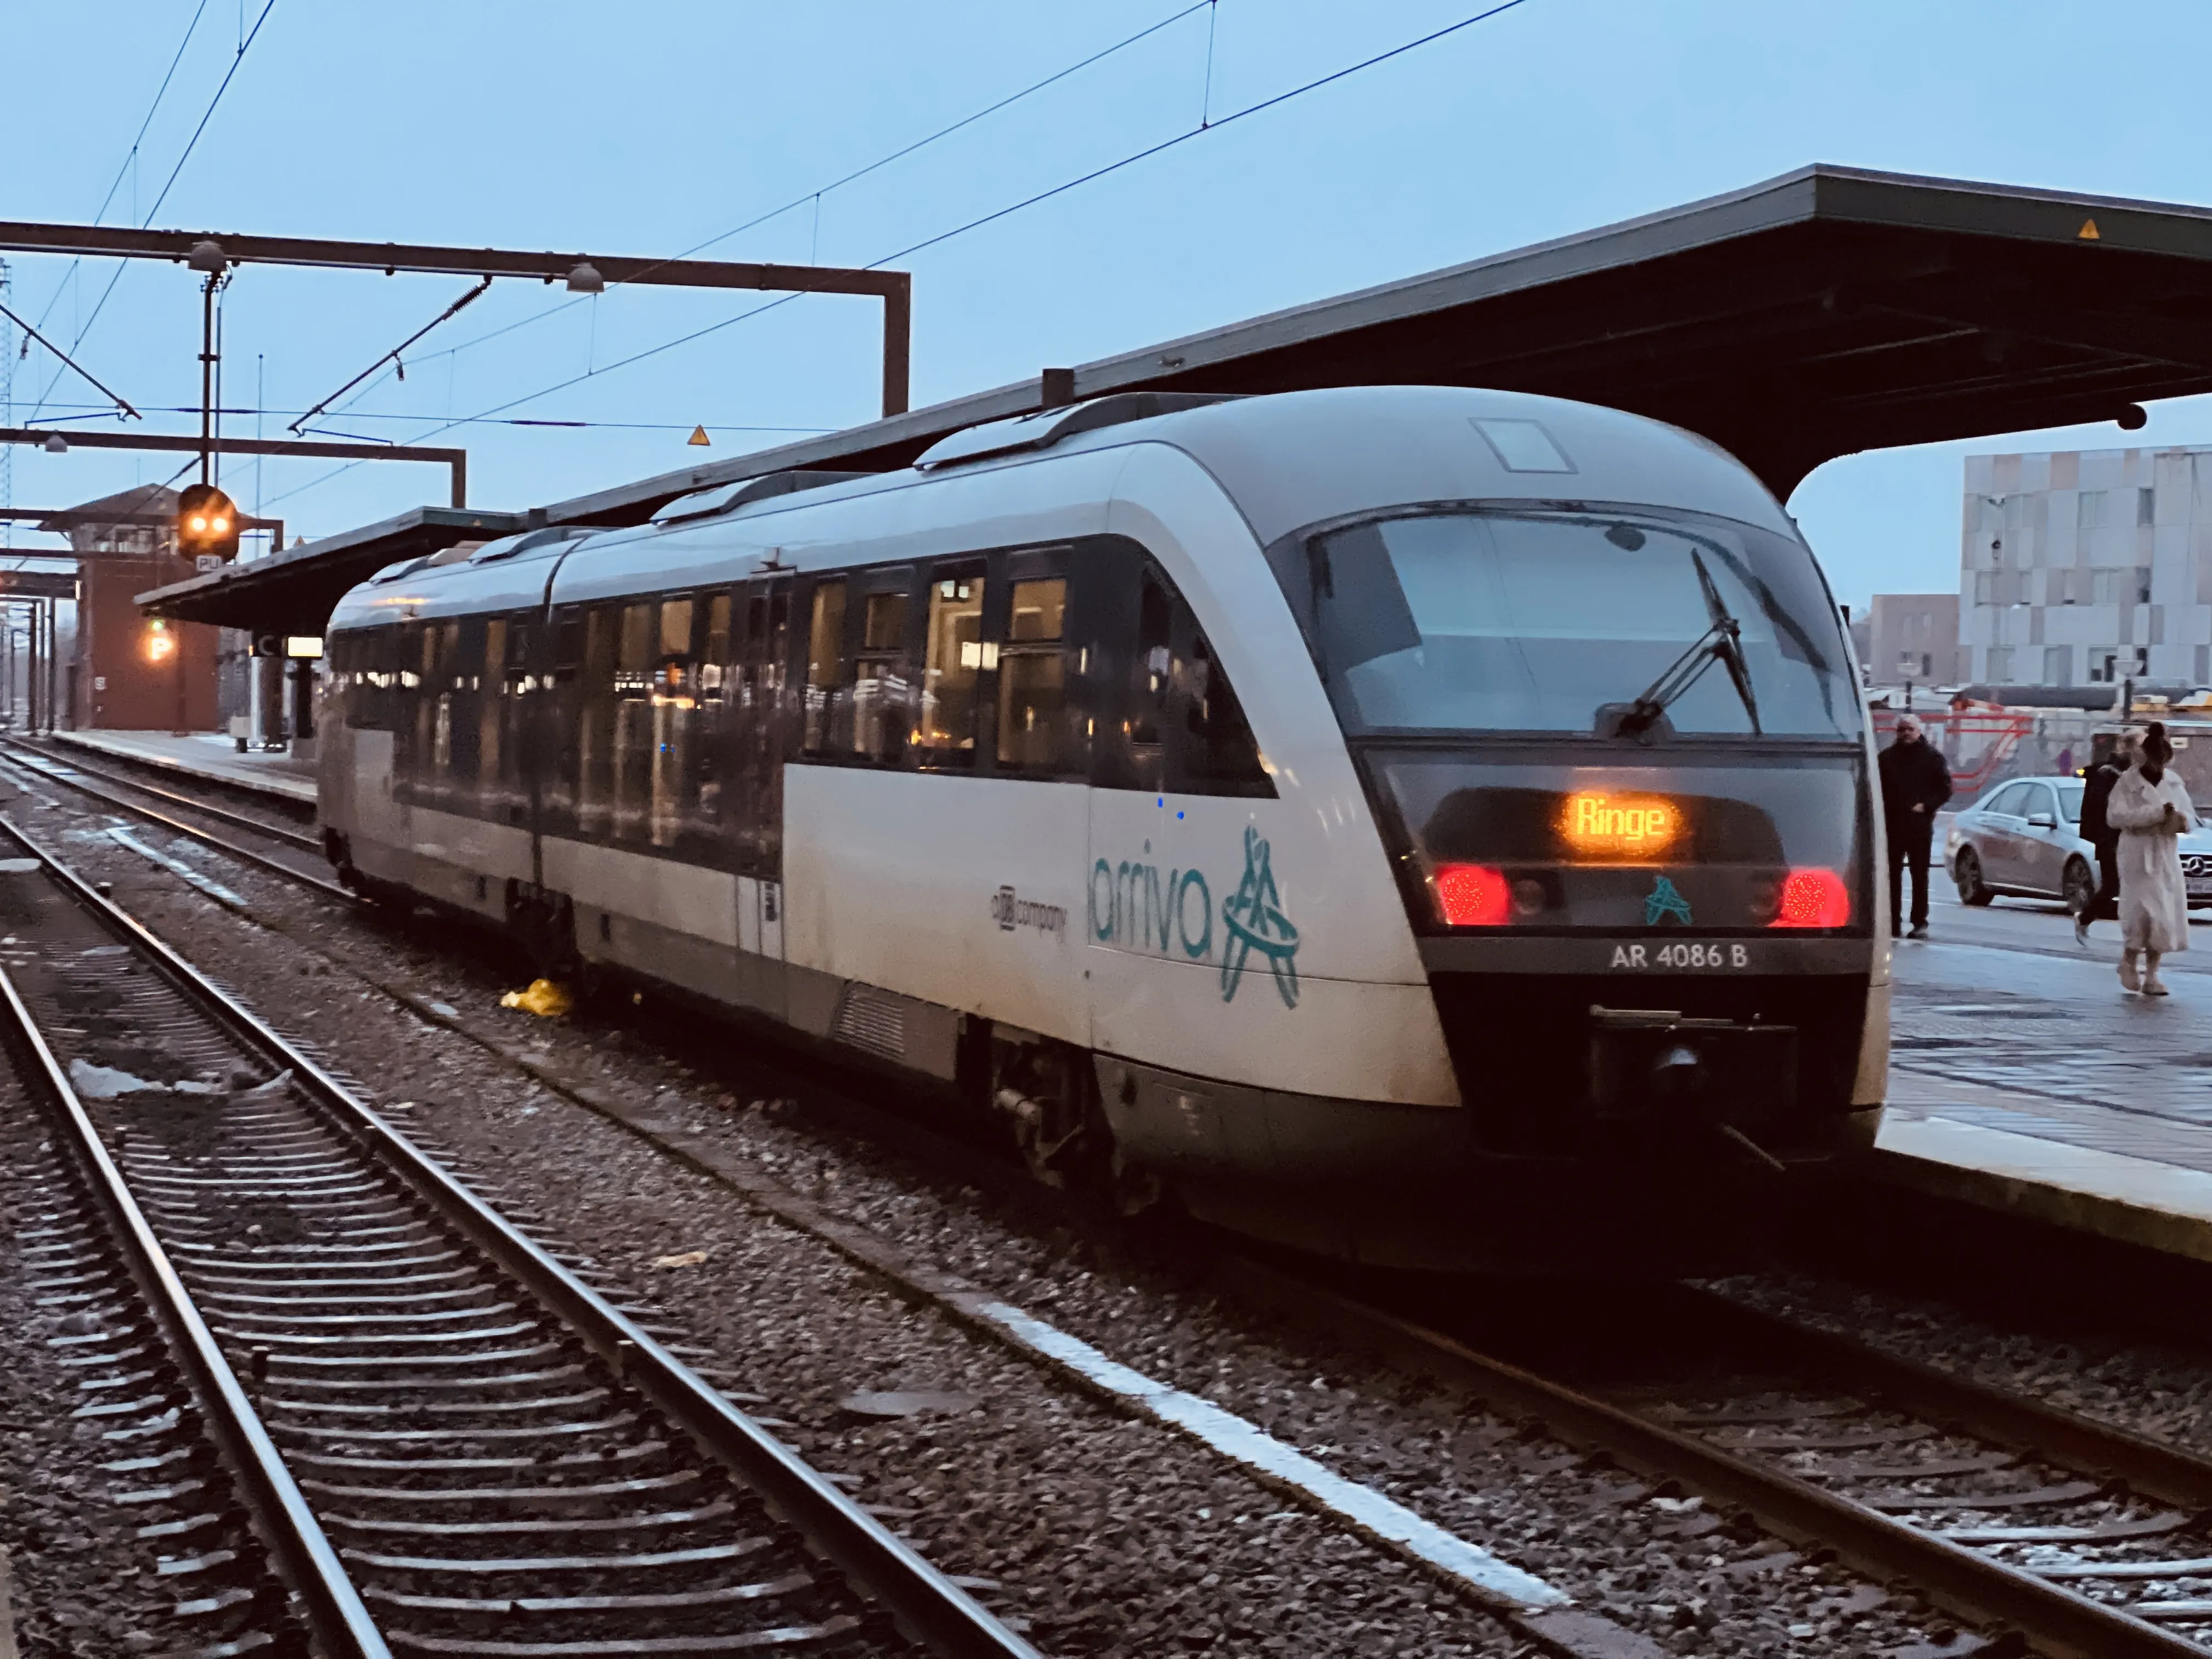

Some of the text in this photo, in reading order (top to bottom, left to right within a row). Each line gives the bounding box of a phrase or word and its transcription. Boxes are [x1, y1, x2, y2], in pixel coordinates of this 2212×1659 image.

[199, 558, 219, 569] PU
[1577, 798, 1665, 840] Ringe
[1612, 944, 1747, 967] AR 4086 B
